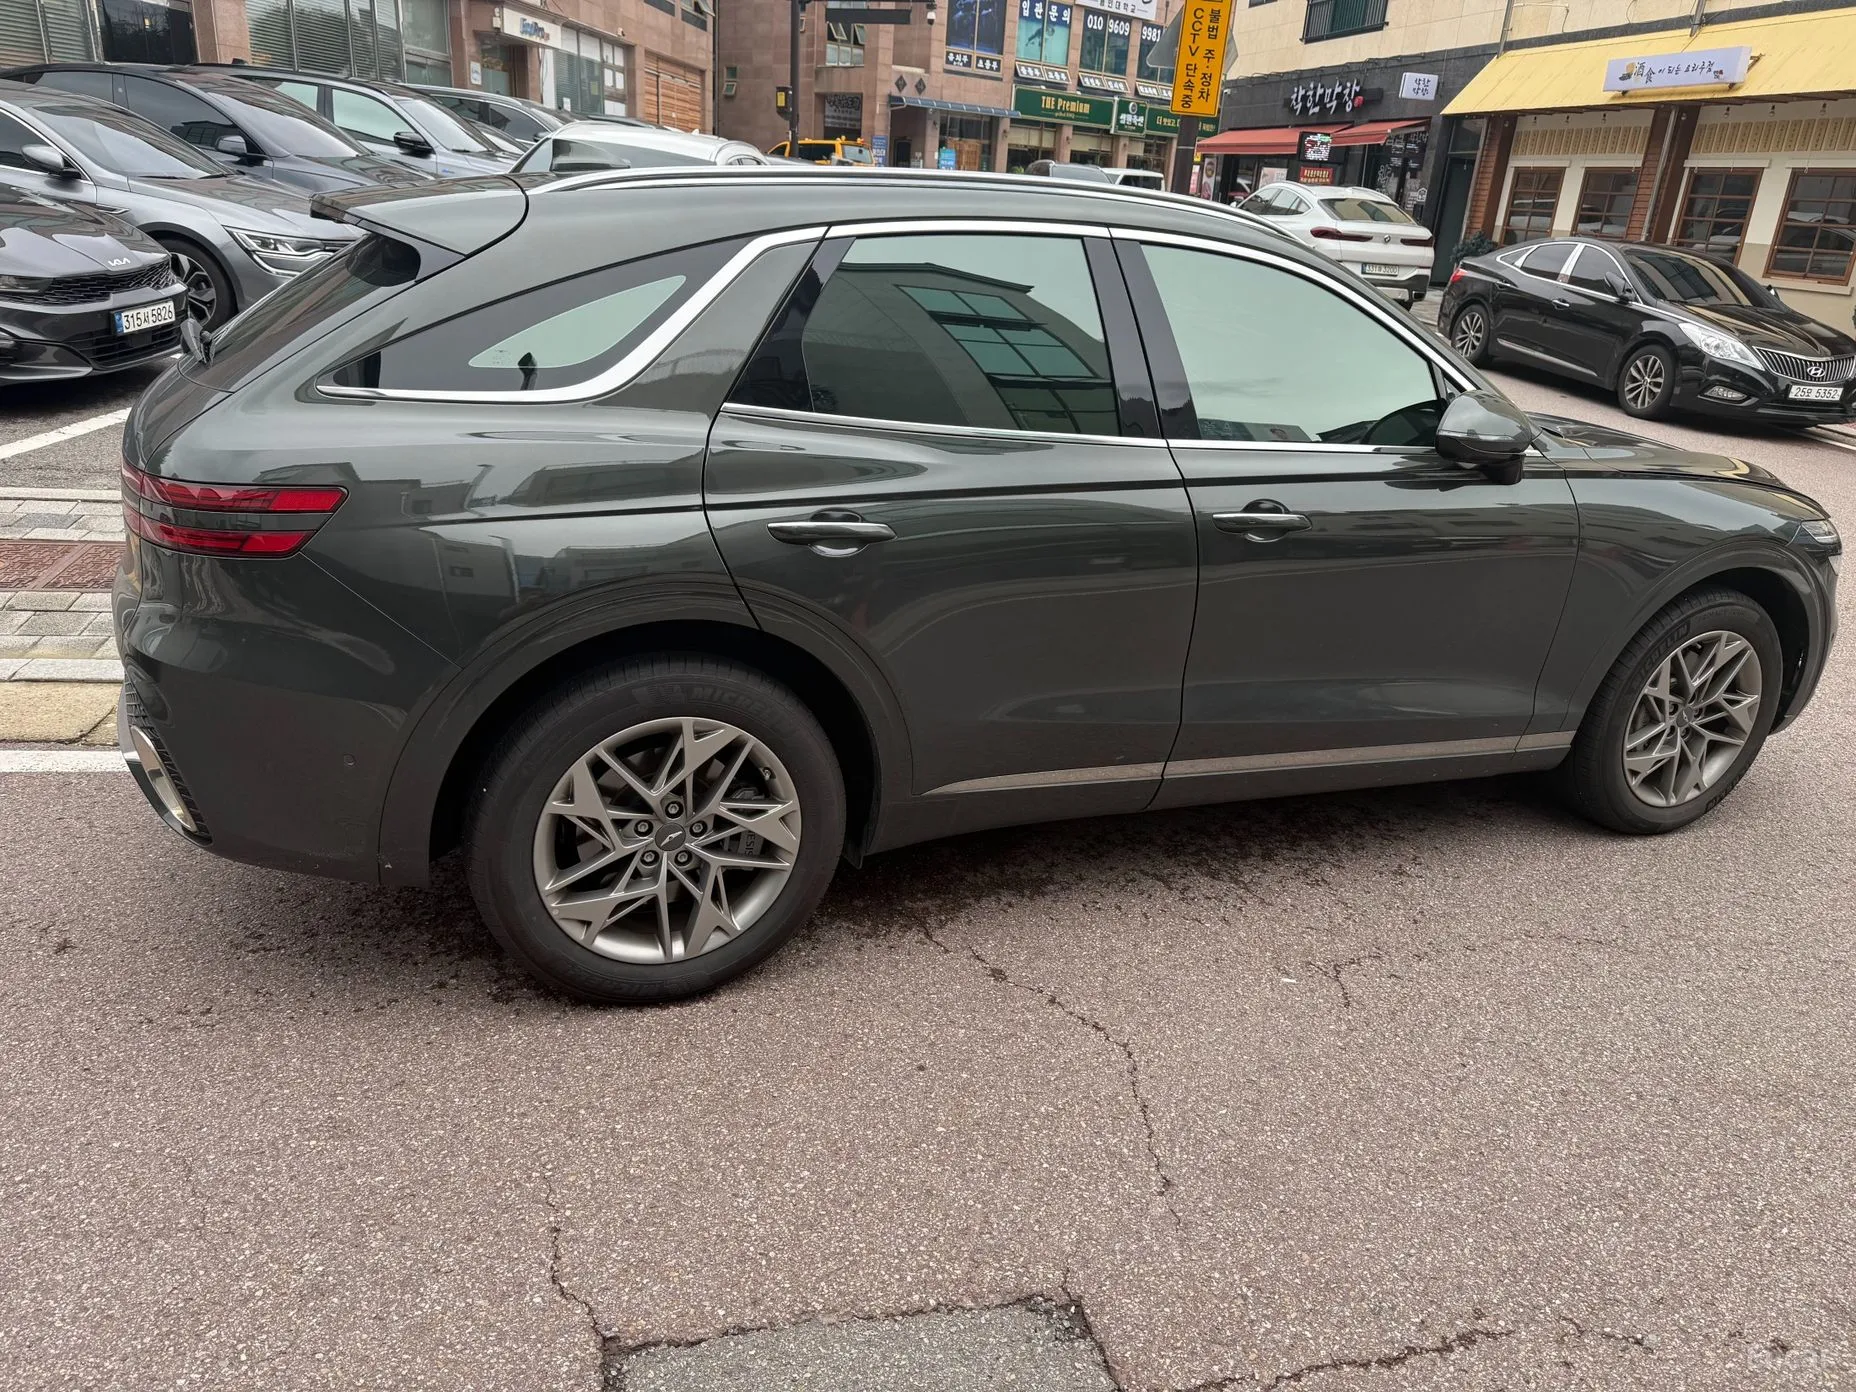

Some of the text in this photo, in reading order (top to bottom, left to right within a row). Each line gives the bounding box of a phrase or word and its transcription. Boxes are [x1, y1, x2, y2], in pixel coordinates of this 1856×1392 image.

[1087, 14, 1161, 42] 010 9609 9981
[1207, 8, 1222, 40] 불법
[1181, 7, 1205, 109] CCTV 단속중
[1041, 96, 1090, 114] THE Premium
[1290, 78, 1361, 116] 착한막창
[123, 304, 174, 330] 315서 5826
[1815, 388, 1839, 399] 5352
